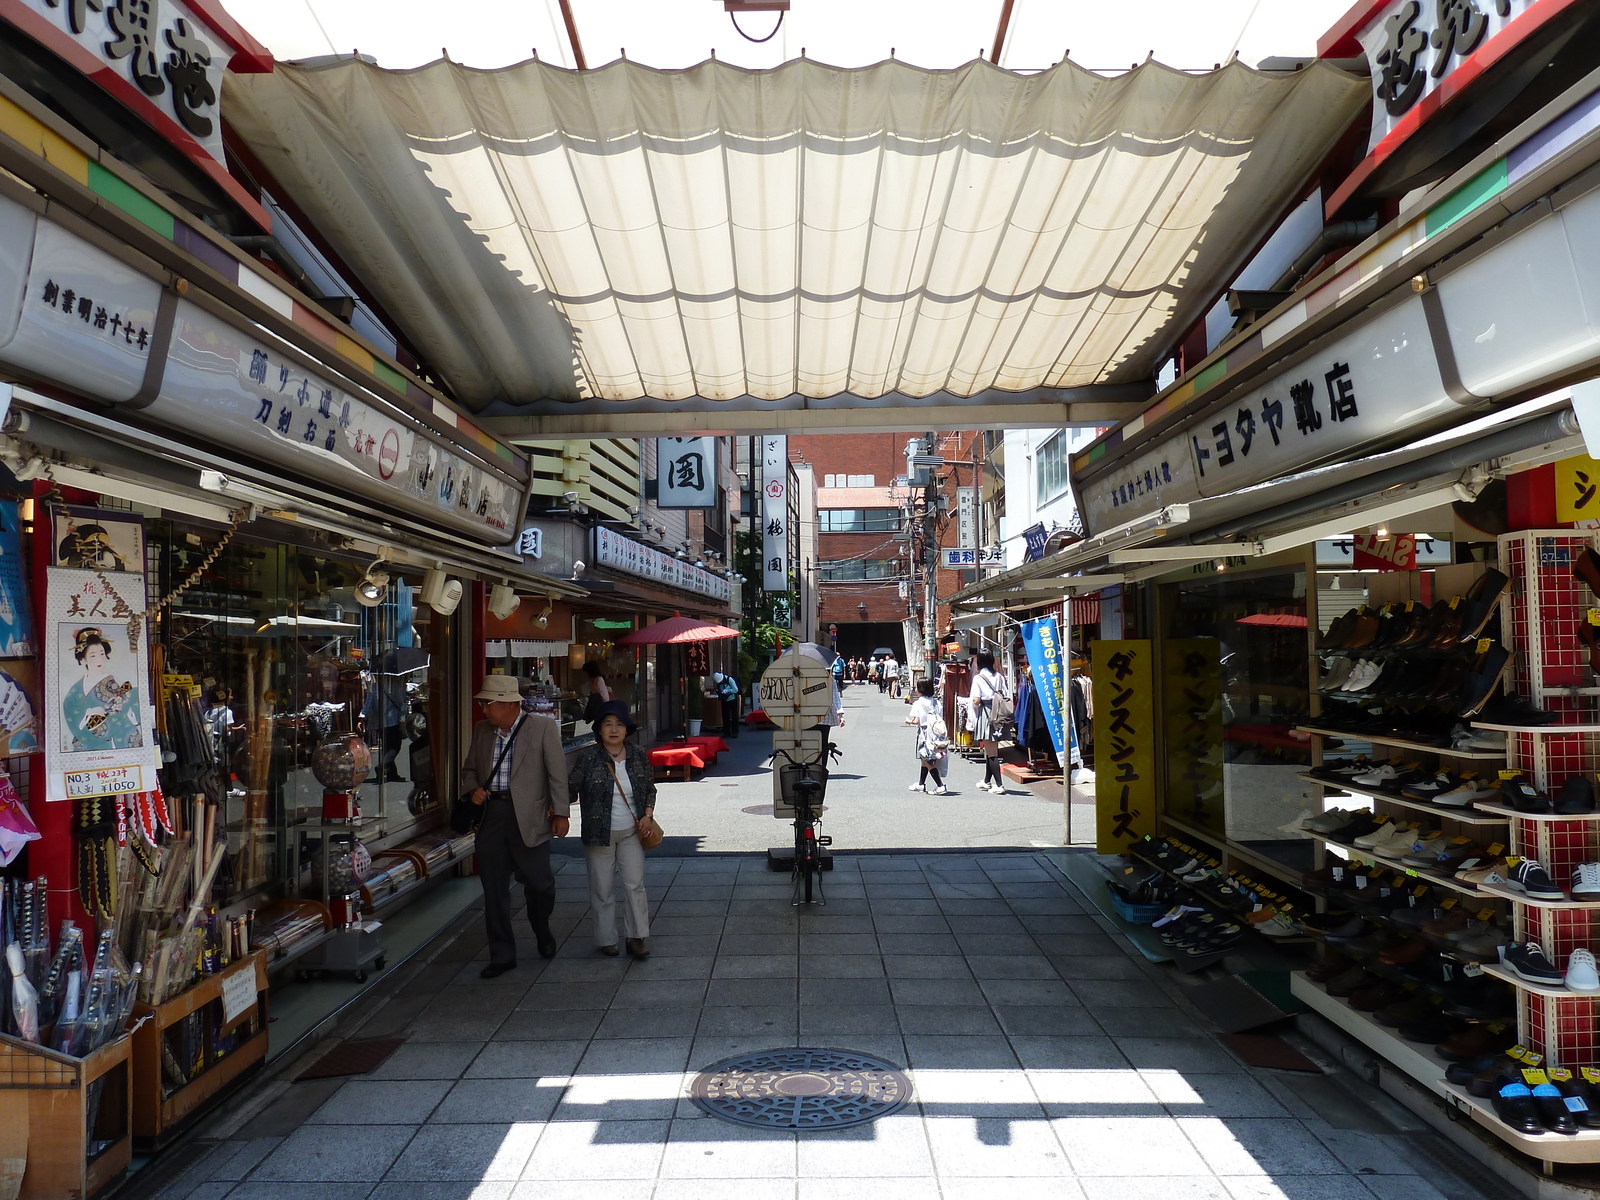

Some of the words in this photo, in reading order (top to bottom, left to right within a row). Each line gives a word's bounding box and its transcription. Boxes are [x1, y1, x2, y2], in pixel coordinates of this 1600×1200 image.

[45, 0, 215, 137] 見世
[42, 278, 149, 351] 創業明治十七年
[668, 437, 704, 491] 園
[1192, 361, 1359, 477] トヨダヤ靴店
[948, 551, 975, 563] 歯科
[1107, 650, 1140, 840] ダンスシューズ
